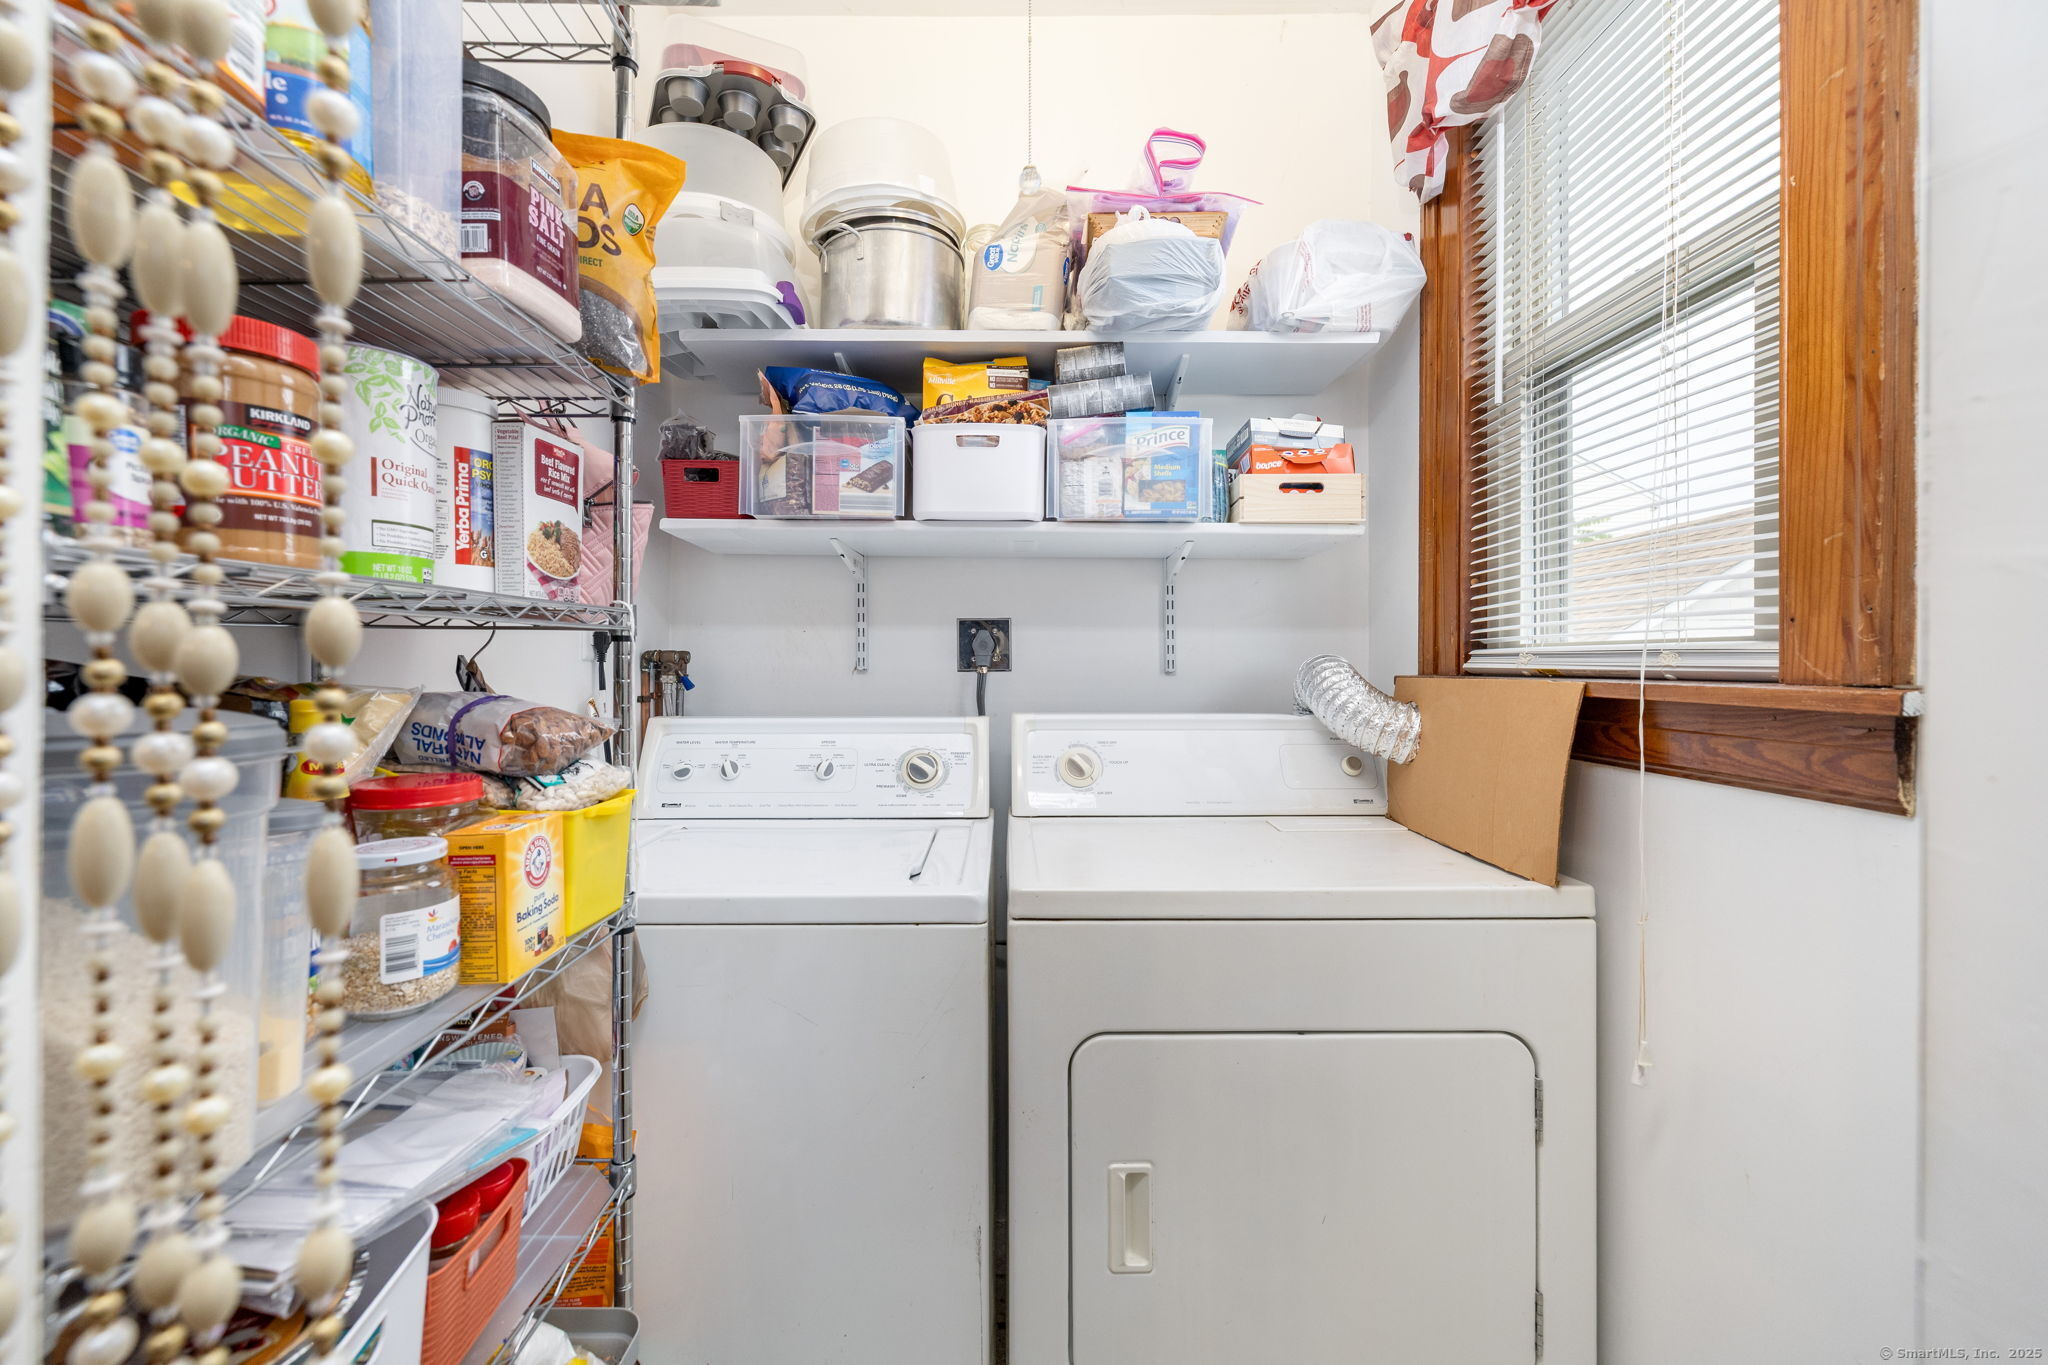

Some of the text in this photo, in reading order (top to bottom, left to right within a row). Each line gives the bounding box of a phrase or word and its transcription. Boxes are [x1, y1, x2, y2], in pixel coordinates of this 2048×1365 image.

[530, 186, 563, 229] PINK
[528, 205, 565, 249] SALT
[249, 407, 311, 431] KIRKLAND
[213, 425, 275, 446] RGANIC
[1134, 430, 1186, 451] Prince
[382, 458, 428, 478] Original
[541, 454, 575, 476] Beef Flavored
[1255, 460, 1283, 470] bounce
[381, 472, 420, 489] Quick
[548, 467, 571, 485] Rice Mix
[455, 463, 470, 552] Yerba Prima
[516, 893, 560, 924] Baking Soda
